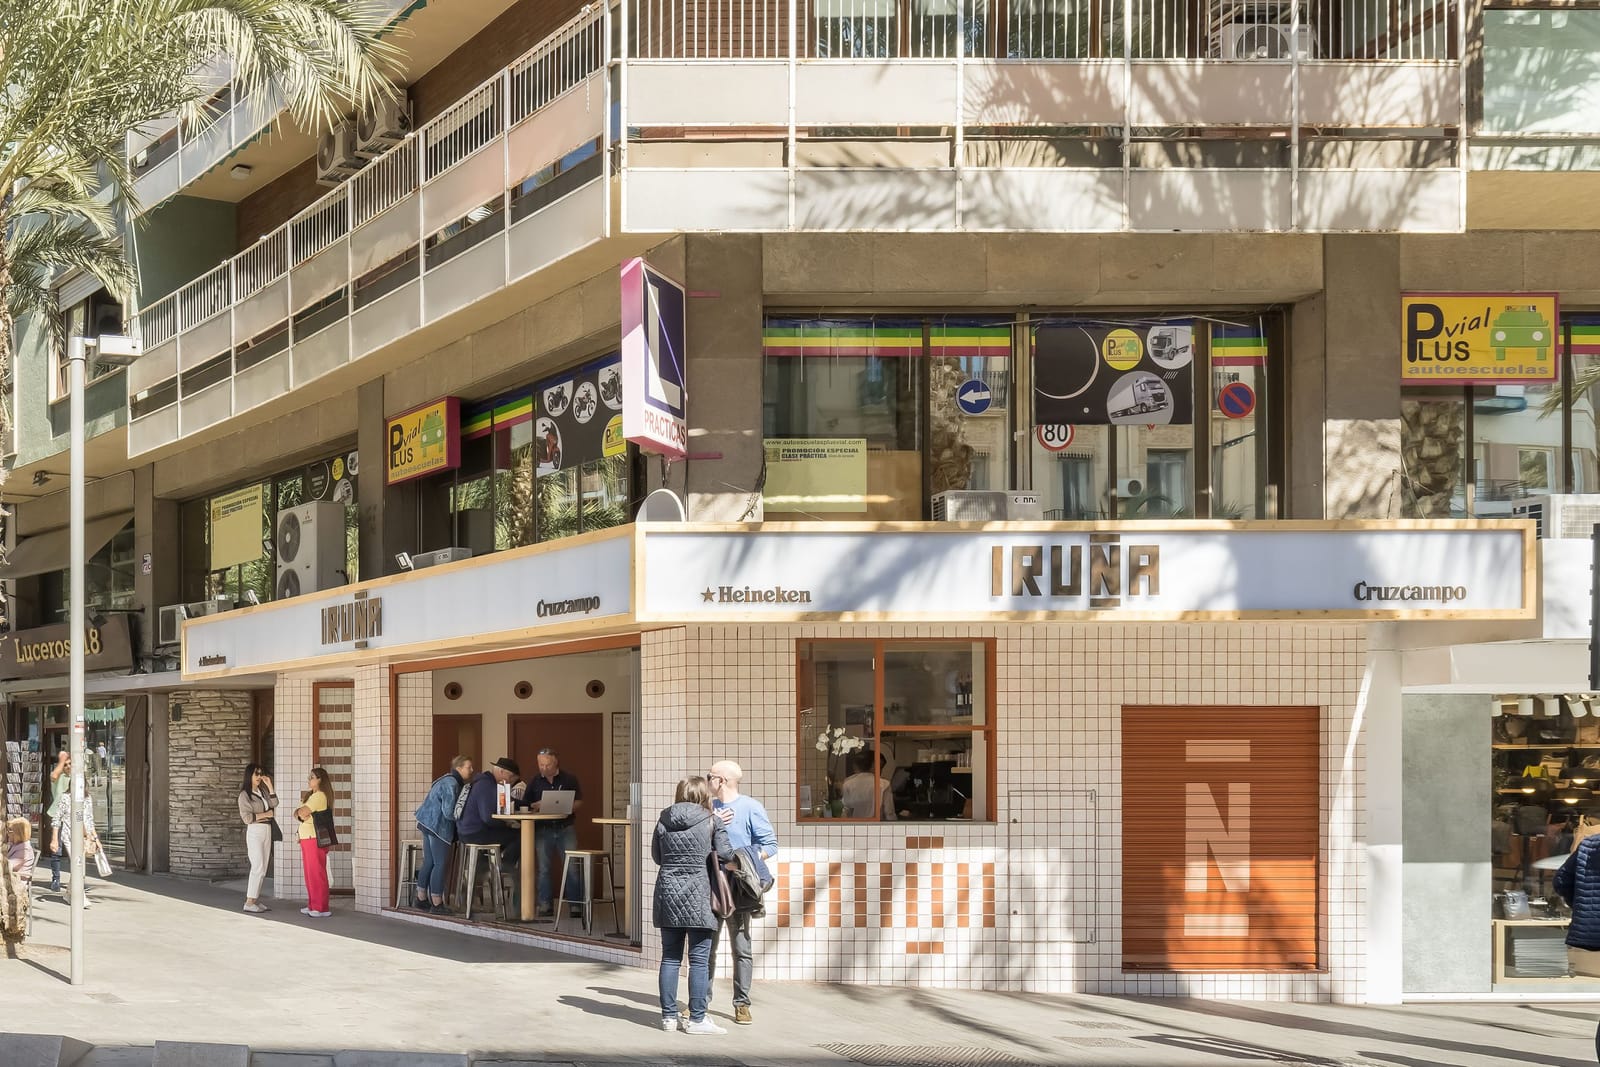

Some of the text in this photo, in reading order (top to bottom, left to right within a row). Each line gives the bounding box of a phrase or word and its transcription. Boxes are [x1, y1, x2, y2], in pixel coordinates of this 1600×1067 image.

[1444, 307, 1491, 338] vial
[1407, 364, 1549, 375] autoescuelas
[403, 418, 421, 447] vial
[644, 410, 686, 446] PRACTICAS
[1044, 424, 1069, 442] 80
[718, 586, 812, 603] Heineken
[1354, 581, 1467, 603] Cruzcampo
[537, 596, 600, 617] Cruzcampo
[14, 638, 71, 663] Luceros
